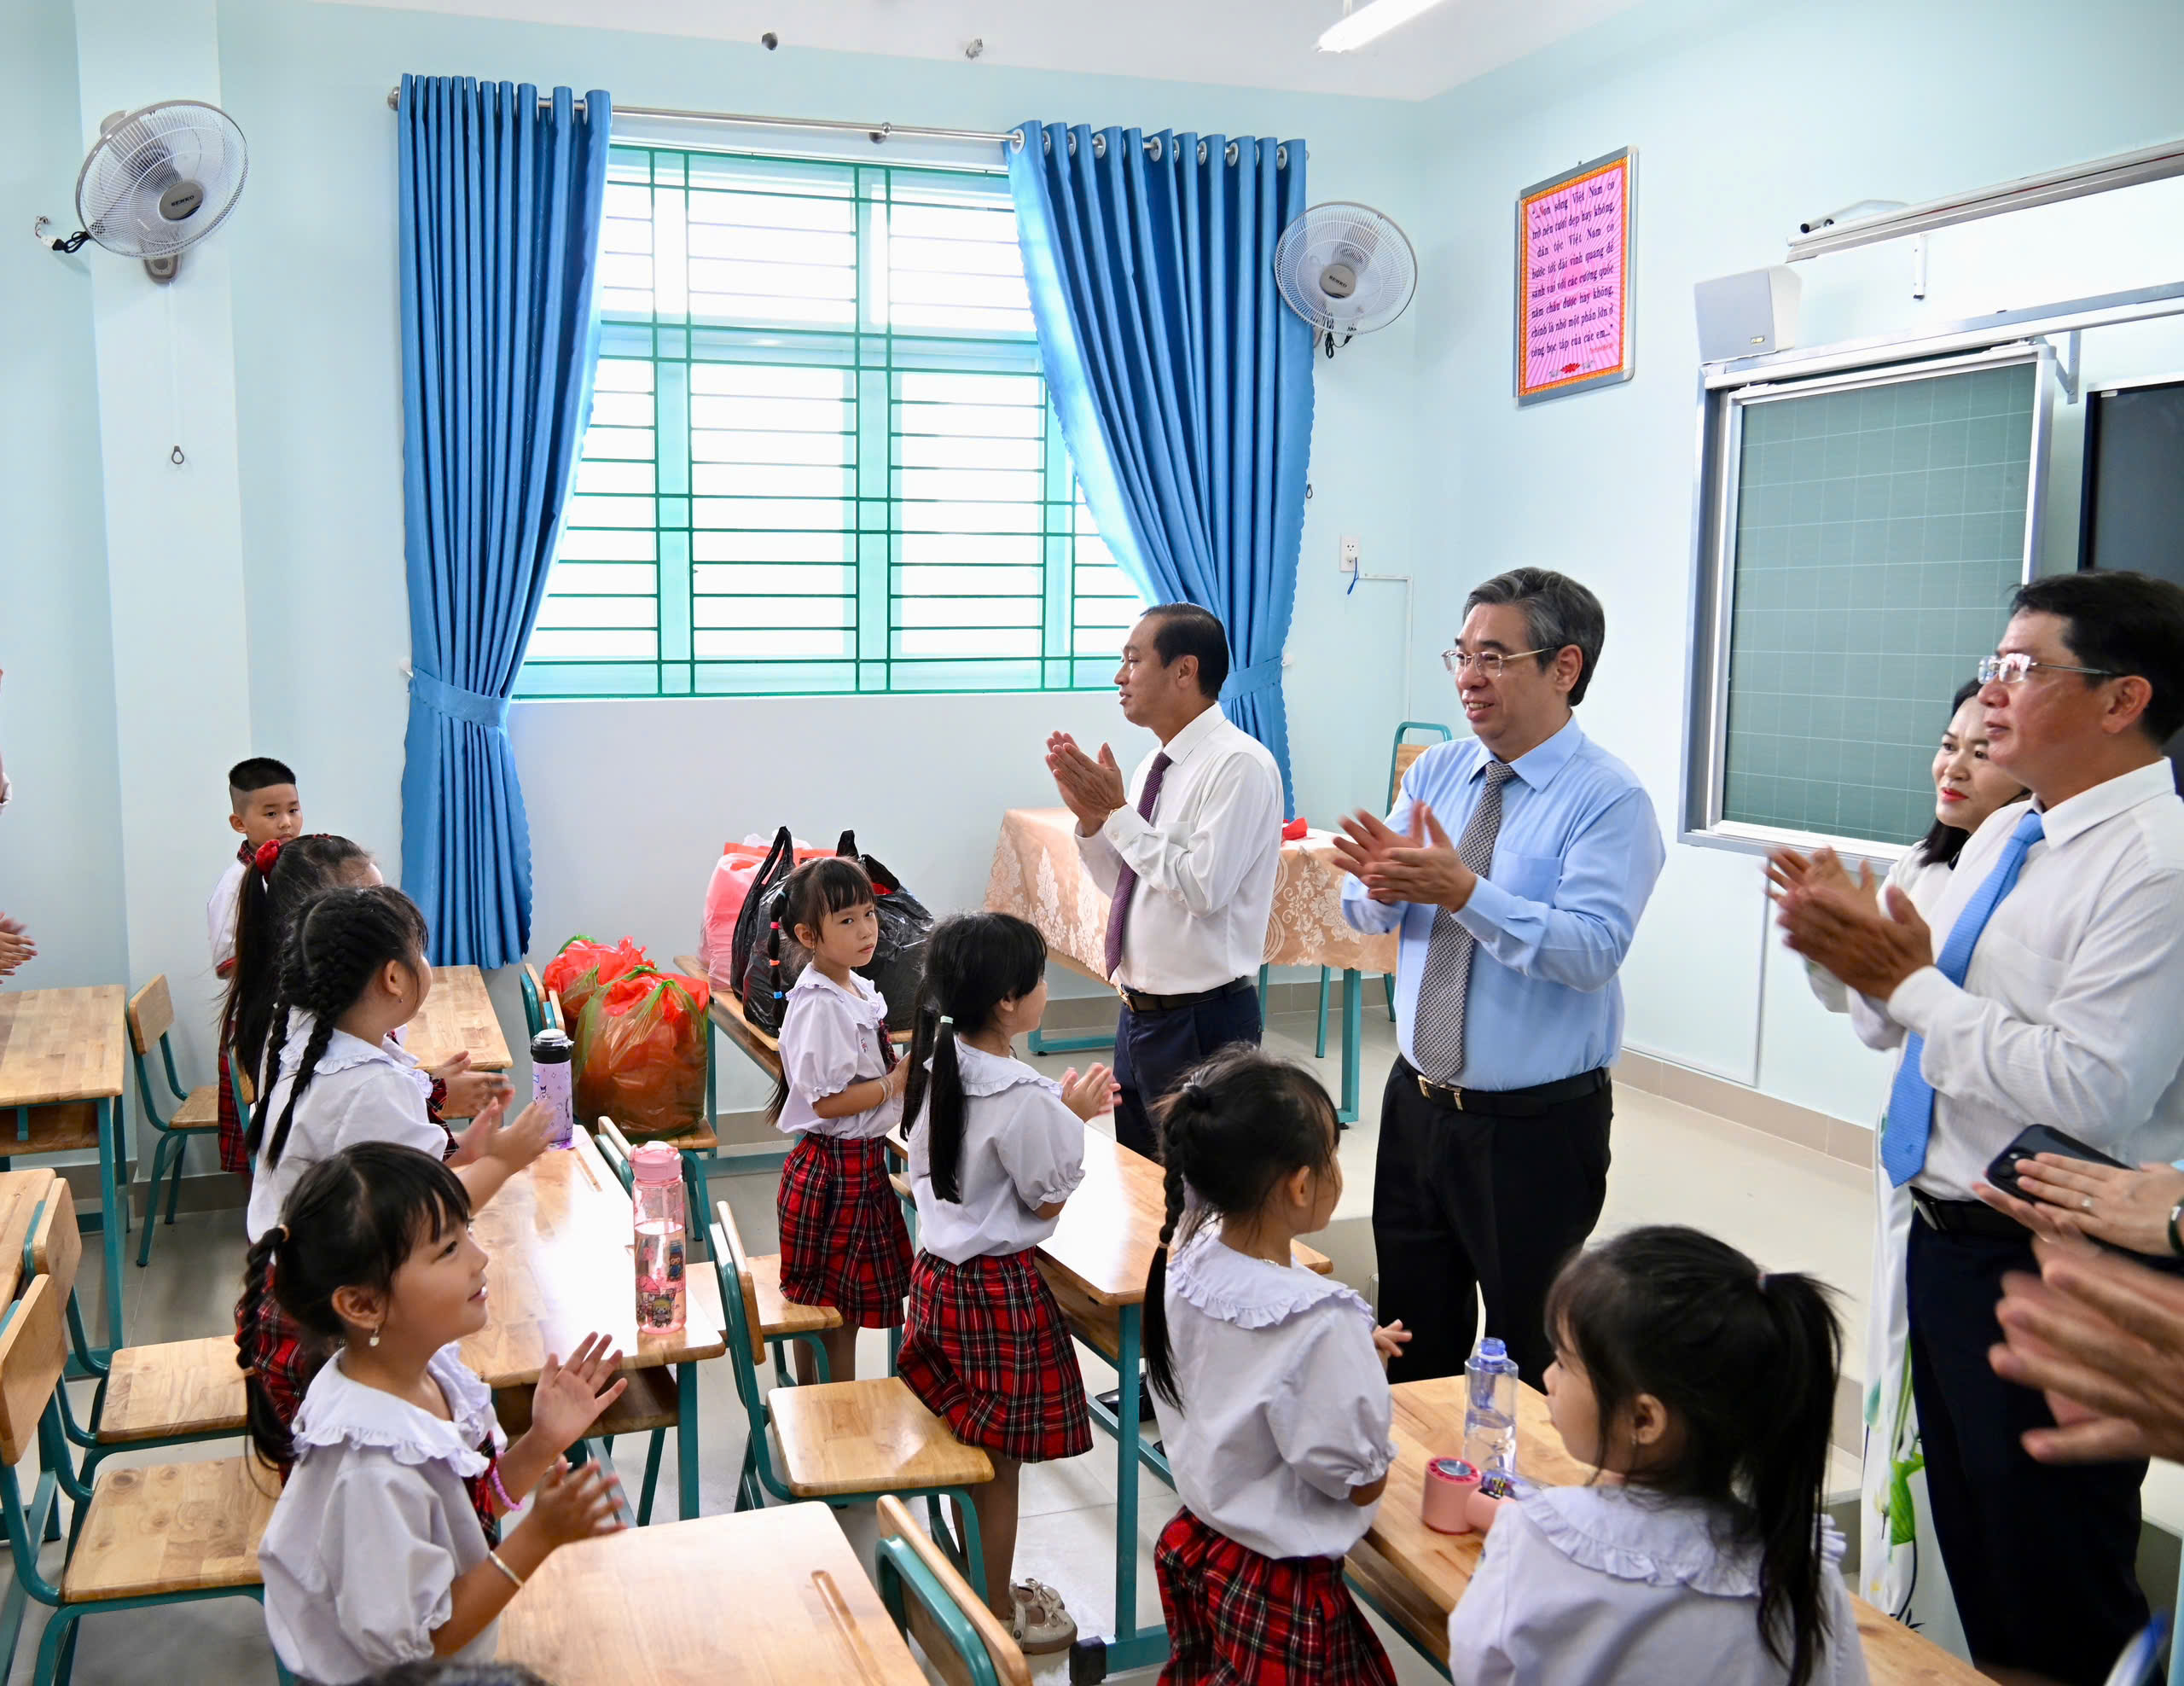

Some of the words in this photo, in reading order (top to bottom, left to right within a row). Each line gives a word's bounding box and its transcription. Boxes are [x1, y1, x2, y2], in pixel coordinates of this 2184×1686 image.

[1554, 199, 1568, 210] sông
[1572, 192, 1584, 203] Việt
[1589, 185, 1602, 198] Nam
[1607, 178, 1614, 190] có
[1543, 225, 1553, 236] nên
[1569, 214, 1579, 227] đẹp
[1582, 211, 1592, 222] hay
[1537, 246, 1548, 258] dân
[1554, 241, 1563, 253] tộc
[1569, 234, 1581, 246] Việt
[1587, 228, 1600, 240] Nam
[1607, 220, 1614, 232] có
[1570, 253, 1583, 265] vinh
[1585, 247, 1604, 263] quang
[1532, 285, 1544, 299] sánh
[1547, 281, 1555, 294] vai
[1568, 275, 1577, 287] các
[1600, 260, 1613, 279] quốc
[1547, 299, 1560, 314] châu
[1563, 296, 1577, 309] được
[1580, 292, 1590, 304] hay
[1531, 323, 1547, 337] chính
[1569, 314, 1579, 327] một
[1582, 308, 1595, 326] phần
[1598, 307, 1607, 317] lớn
[1531, 346, 1544, 358] công
[1547, 341, 1556, 354] học
[1560, 338, 1569, 352] tập
[1571, 334, 1581, 346] của
[1583, 330, 1594, 342] các
